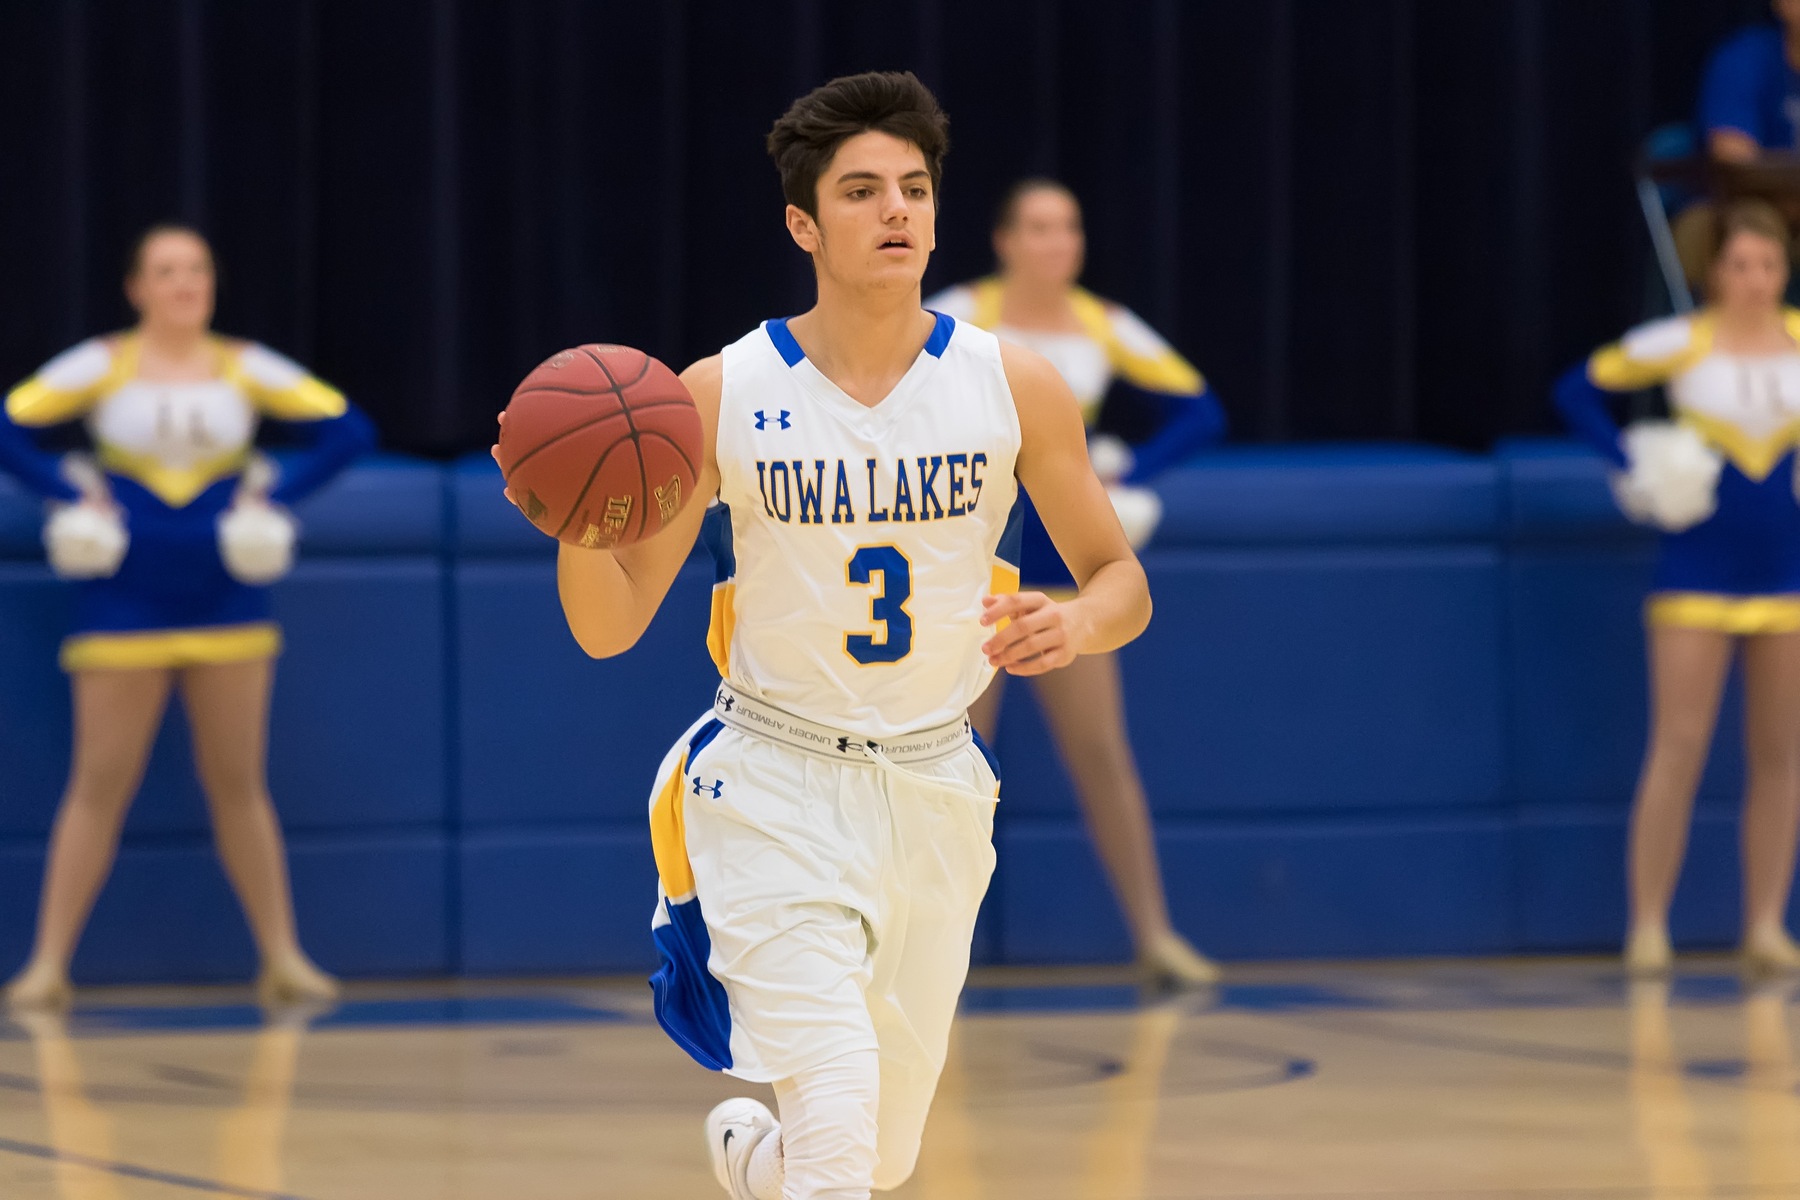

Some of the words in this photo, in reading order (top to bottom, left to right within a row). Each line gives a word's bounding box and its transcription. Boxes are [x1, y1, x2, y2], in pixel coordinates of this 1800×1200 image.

[756, 459, 855, 525] IOWA
[866, 452, 988, 525] LAKES
[842, 541, 915, 668] 3
[736, 704, 785, 730] ARMOUR
[788, 725, 831, 746] UNDER
[936, 728, 964, 747] UNDER
[885, 745, 933, 754] ARMOUR
